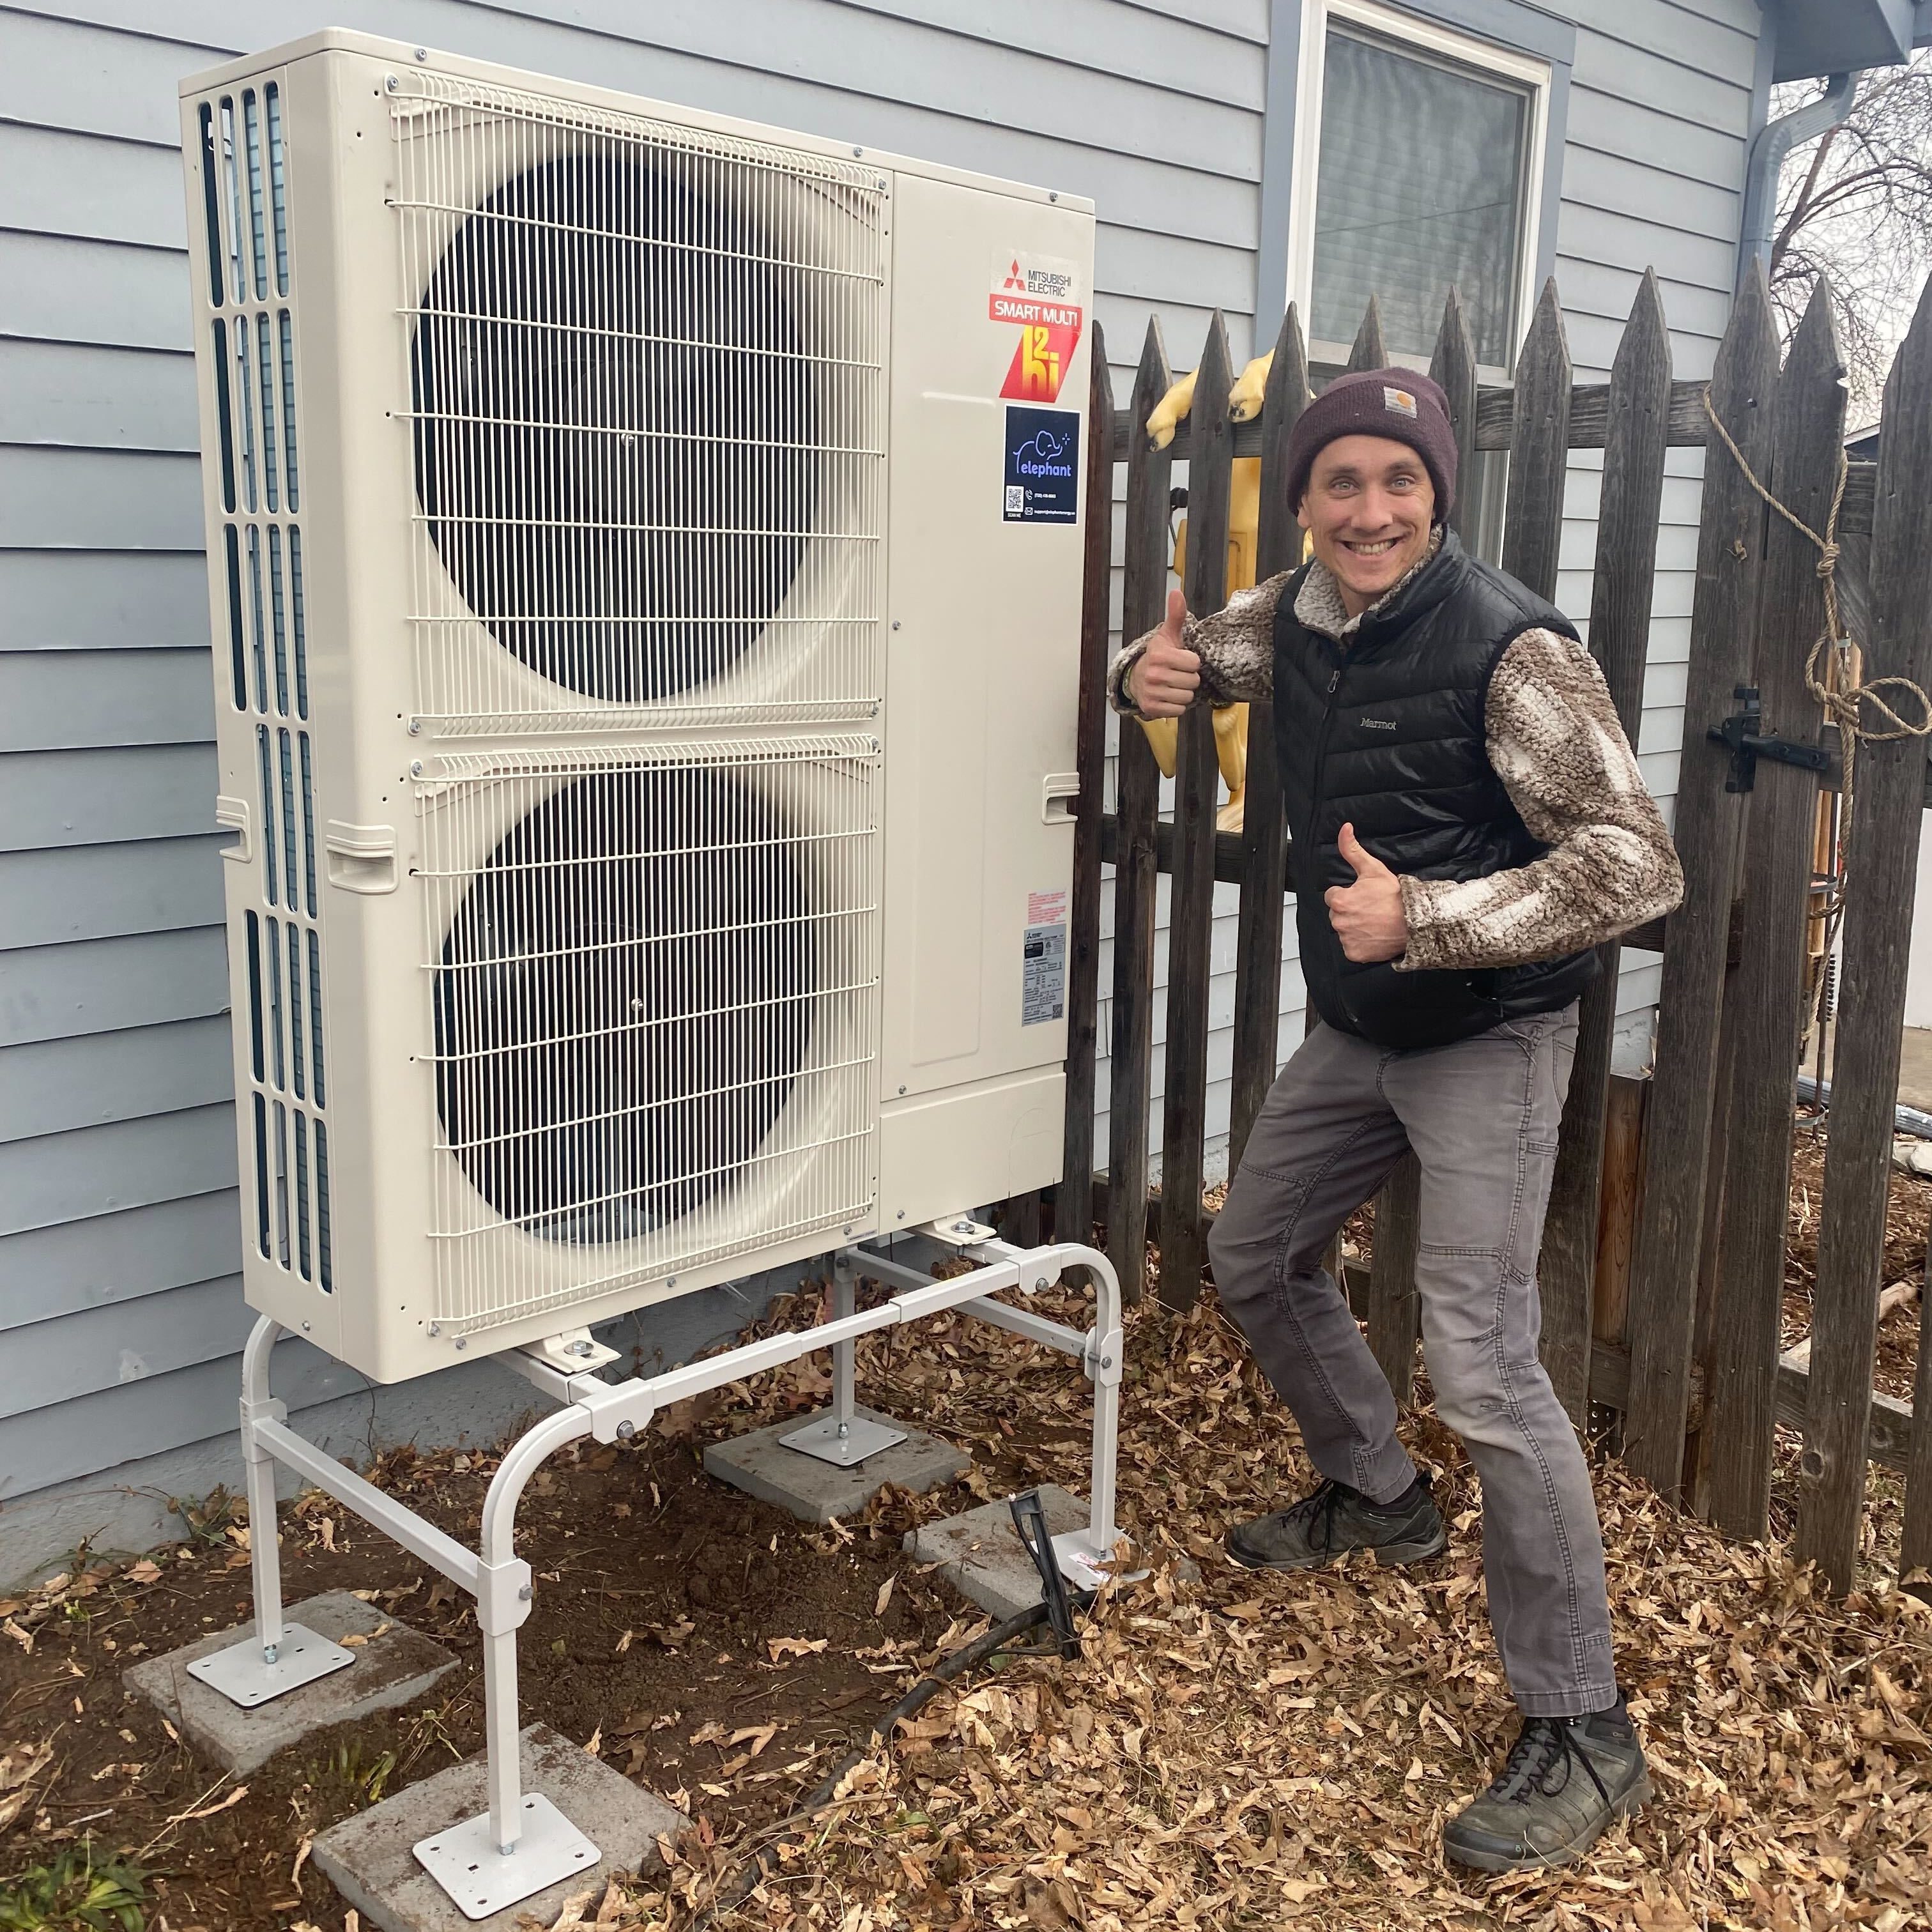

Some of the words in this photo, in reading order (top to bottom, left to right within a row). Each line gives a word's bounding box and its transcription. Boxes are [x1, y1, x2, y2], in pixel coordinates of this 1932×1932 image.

[1028, 269, 1071, 287] MITSUBISHI
[1028, 282, 1066, 297] ELECTRIC
[995, 300, 1041, 322] SMART
[1043, 307, 1078, 327] MULTI
[1021, 461, 1071, 478] elephant
[1360, 717, 1397, 730] Marmot
